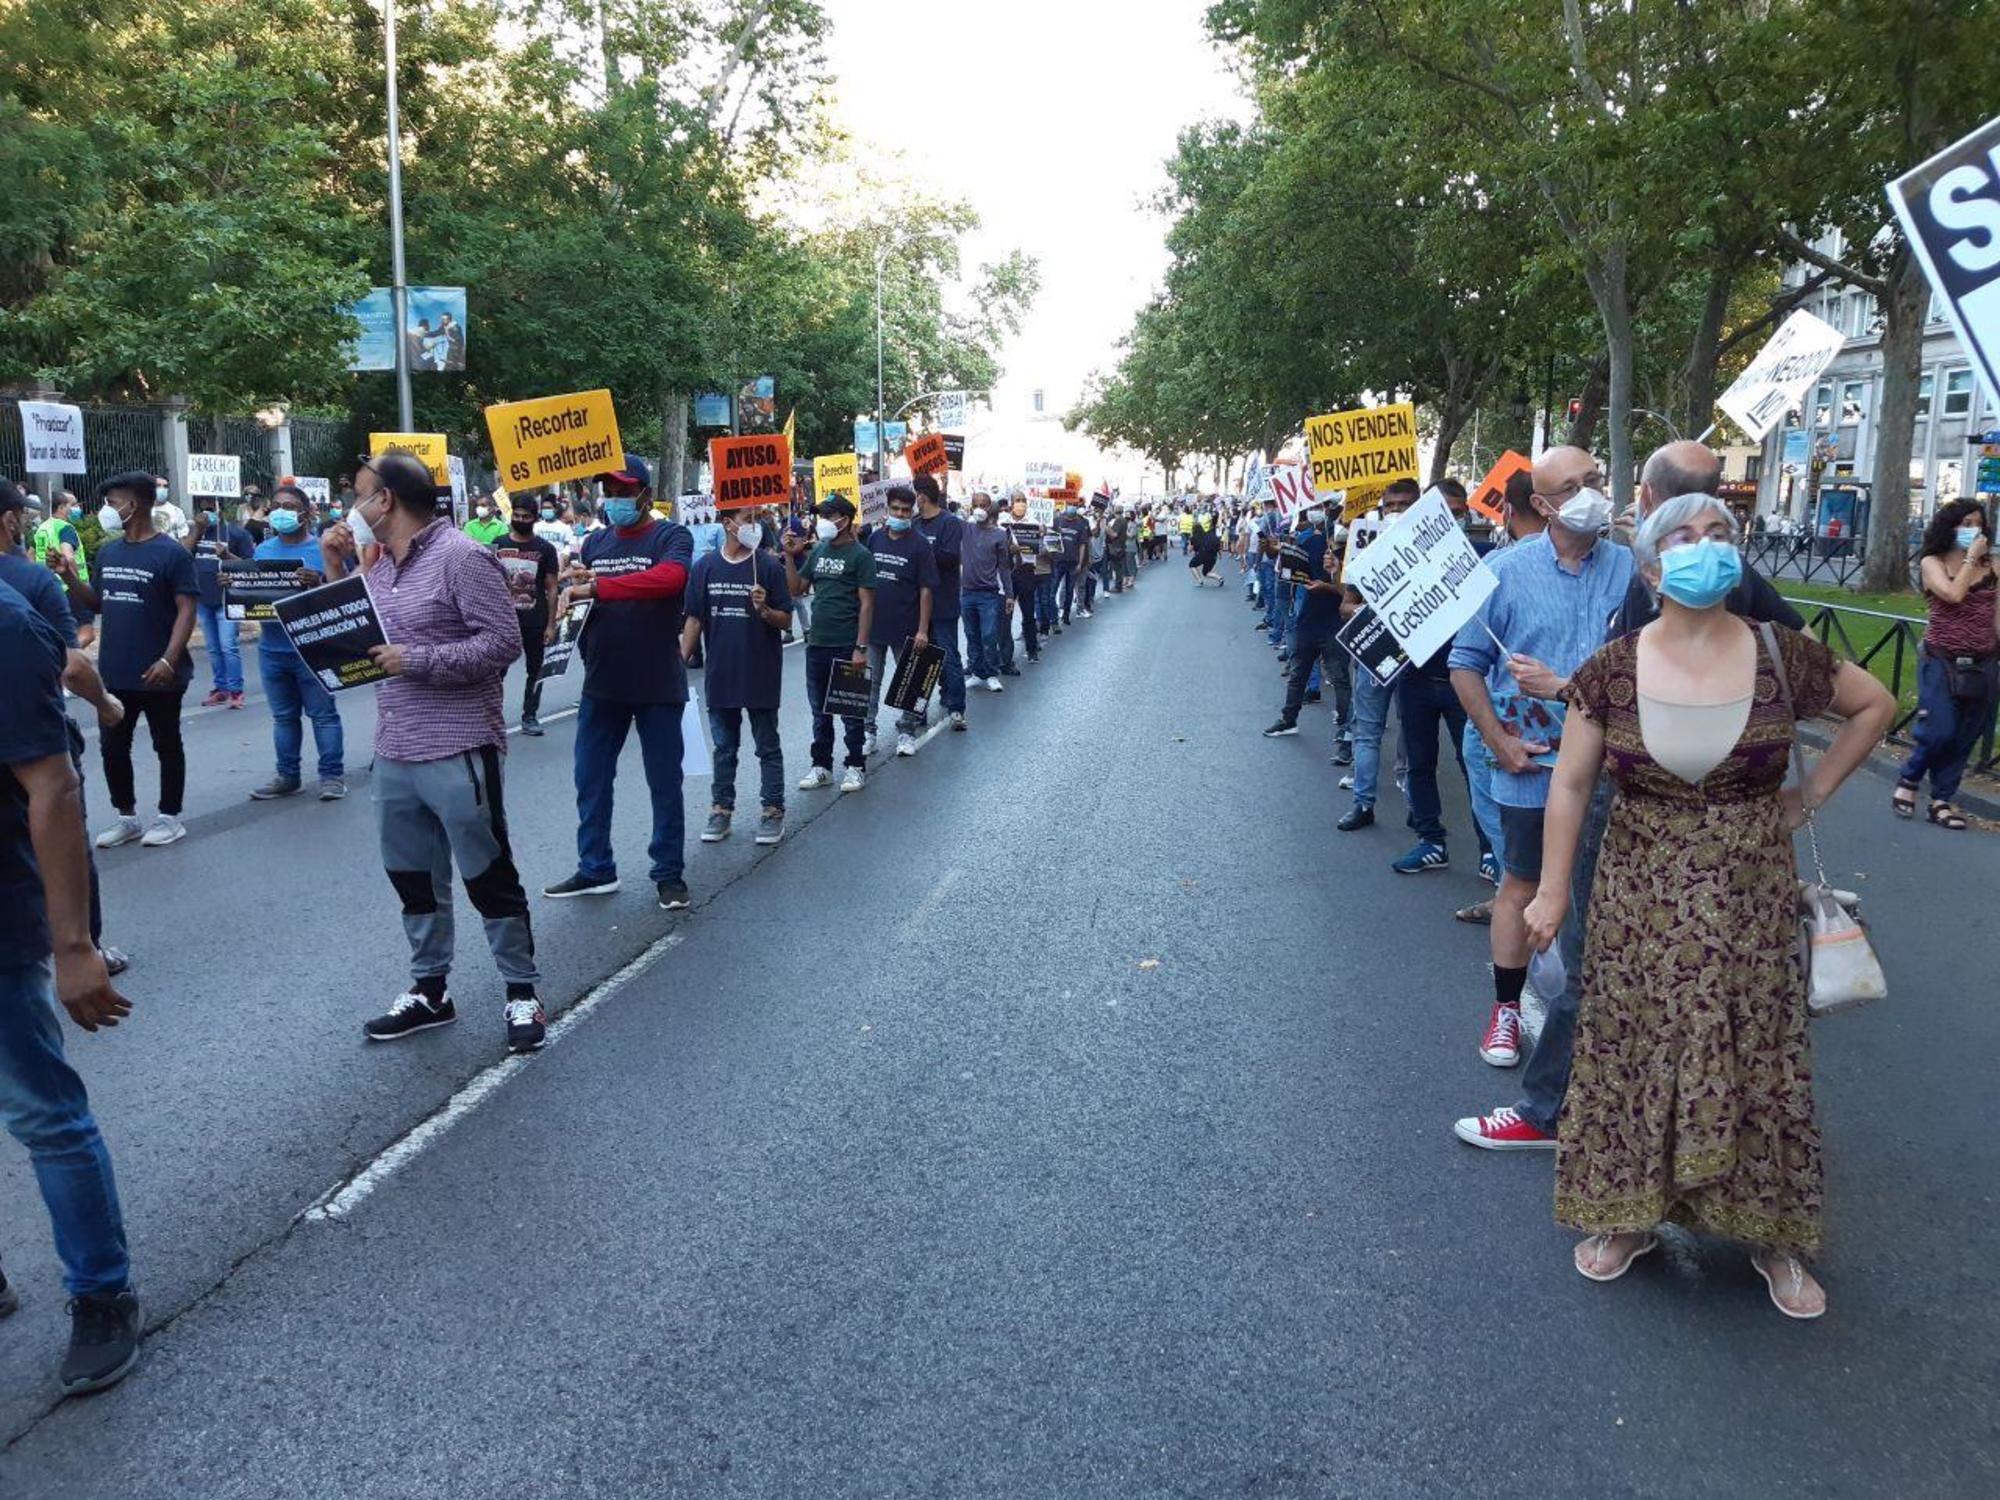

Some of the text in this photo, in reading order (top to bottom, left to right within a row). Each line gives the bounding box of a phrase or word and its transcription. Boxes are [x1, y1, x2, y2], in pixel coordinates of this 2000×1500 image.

[1929, 144, 2000, 271] S
[514, 407, 588, 449] ¡Recortar
[1308, 411, 1413, 455] ¡NOS VENDEN,
[191, 455, 236, 473] DERECHO
[510, 434, 614, 481] es maltratar!
[821, 463, 853, 477] Derechos
[1312, 446, 1416, 485] PRIVATIZAN!
[720, 474, 786, 502] ABUSOS.
[1360, 503, 1455, 603] Salvar lo público!
[280, 571, 299, 579] TODO
[1388, 541, 1479, 639] Gestión pública!
[320, 607, 341, 621] PARA
[340, 598, 370, 615] TODOS
